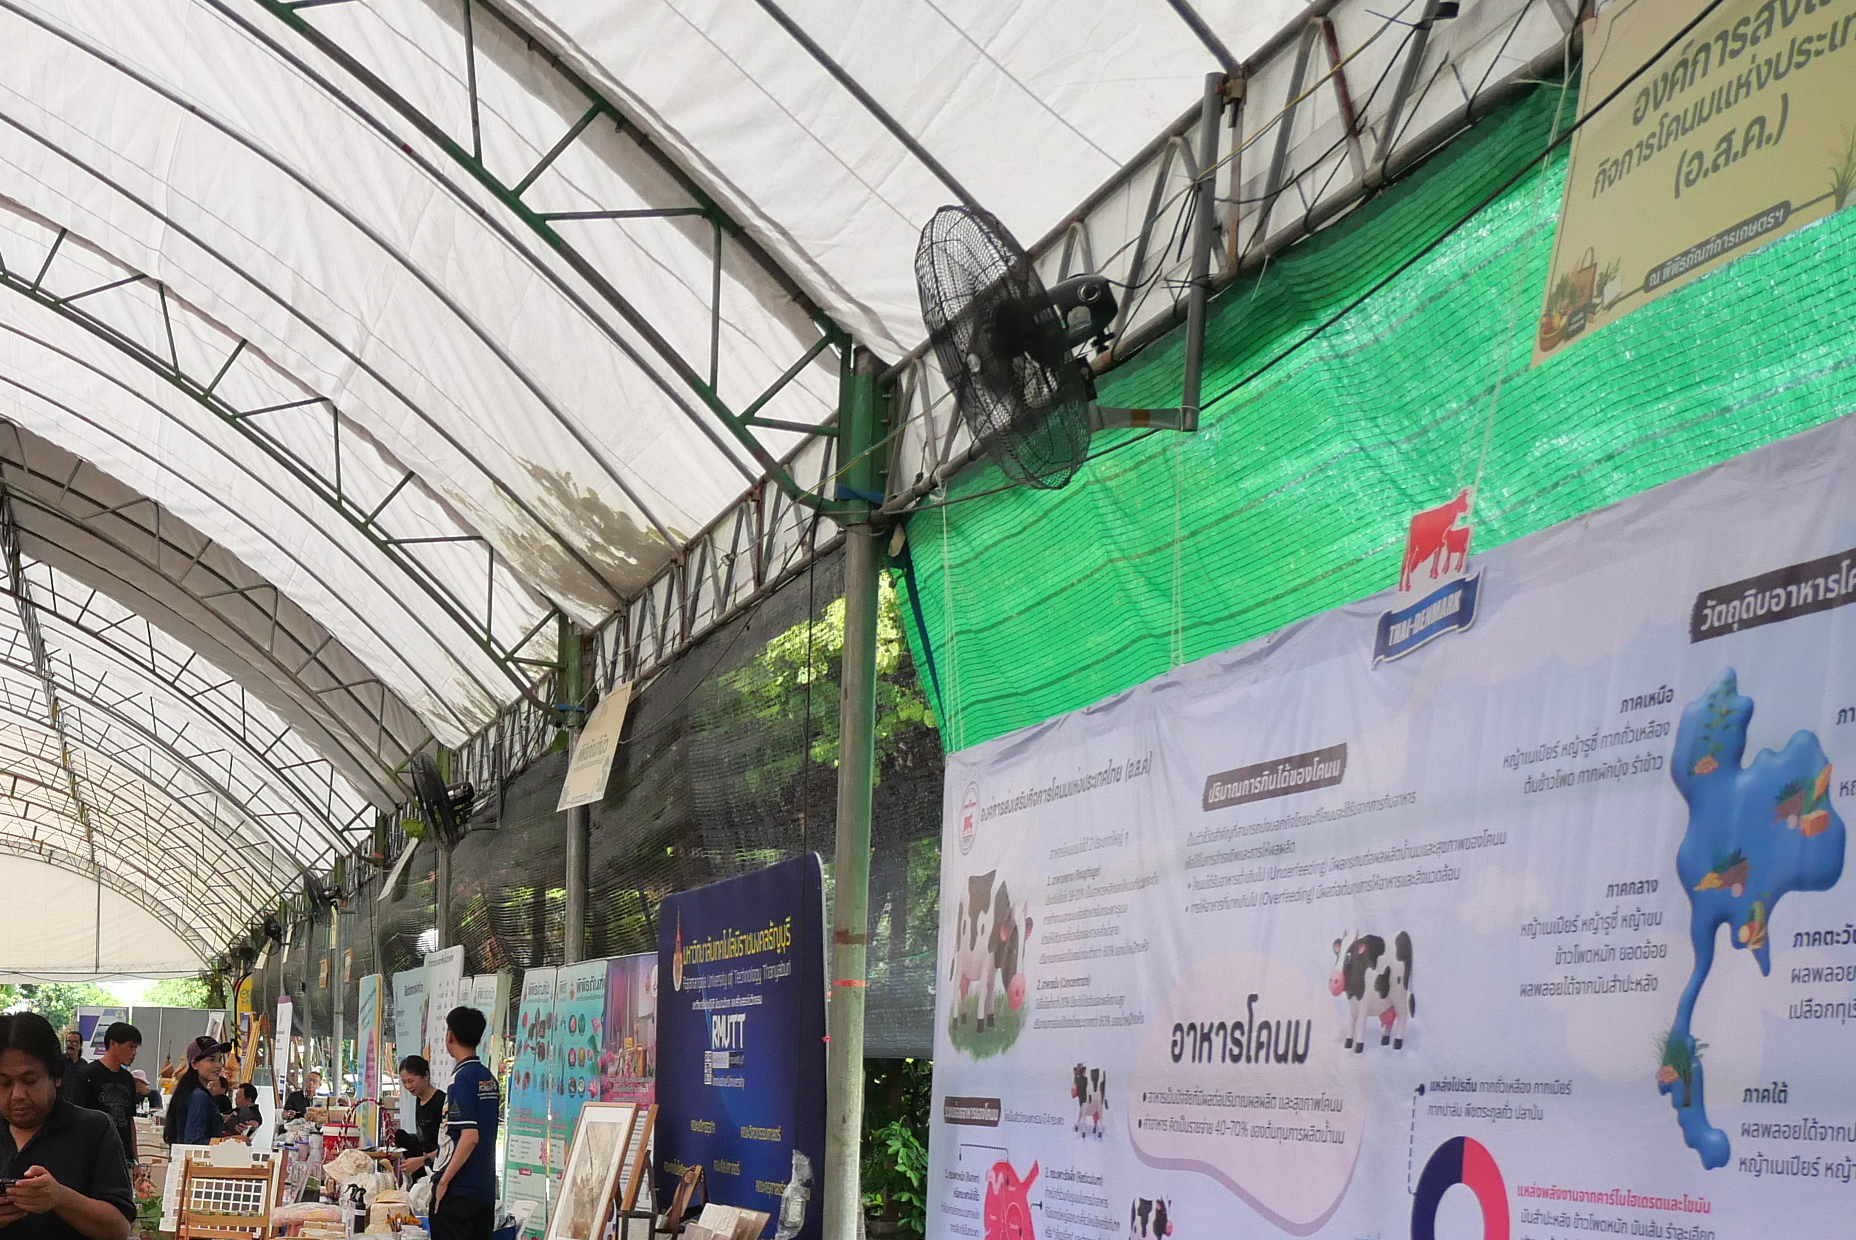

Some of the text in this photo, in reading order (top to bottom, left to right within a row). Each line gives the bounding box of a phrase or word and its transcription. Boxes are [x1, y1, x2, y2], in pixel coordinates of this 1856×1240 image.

[1675, 92, 1789, 199] (อ.ส.ค.)
[1620, 685, 1674, 713] ภาคเหนือ
[1208, 757, 1341, 804] ปริมาณการกินได้ของโคนม
[1606, 879, 1658, 898] ภาคกลาง
[1555, 944, 1615, 965] ข้าวโพดหมัก
[712, 1013, 746, 1049] RMUTT
[1171, 993, 1311, 1064] อาหารโคนม
[1742, 1082, 1788, 1104] ภาคใต้
[1215, 1119, 1249, 1137] 40-70%
[1739, 1151, 1822, 1177] หญ้าเนเปียร์
